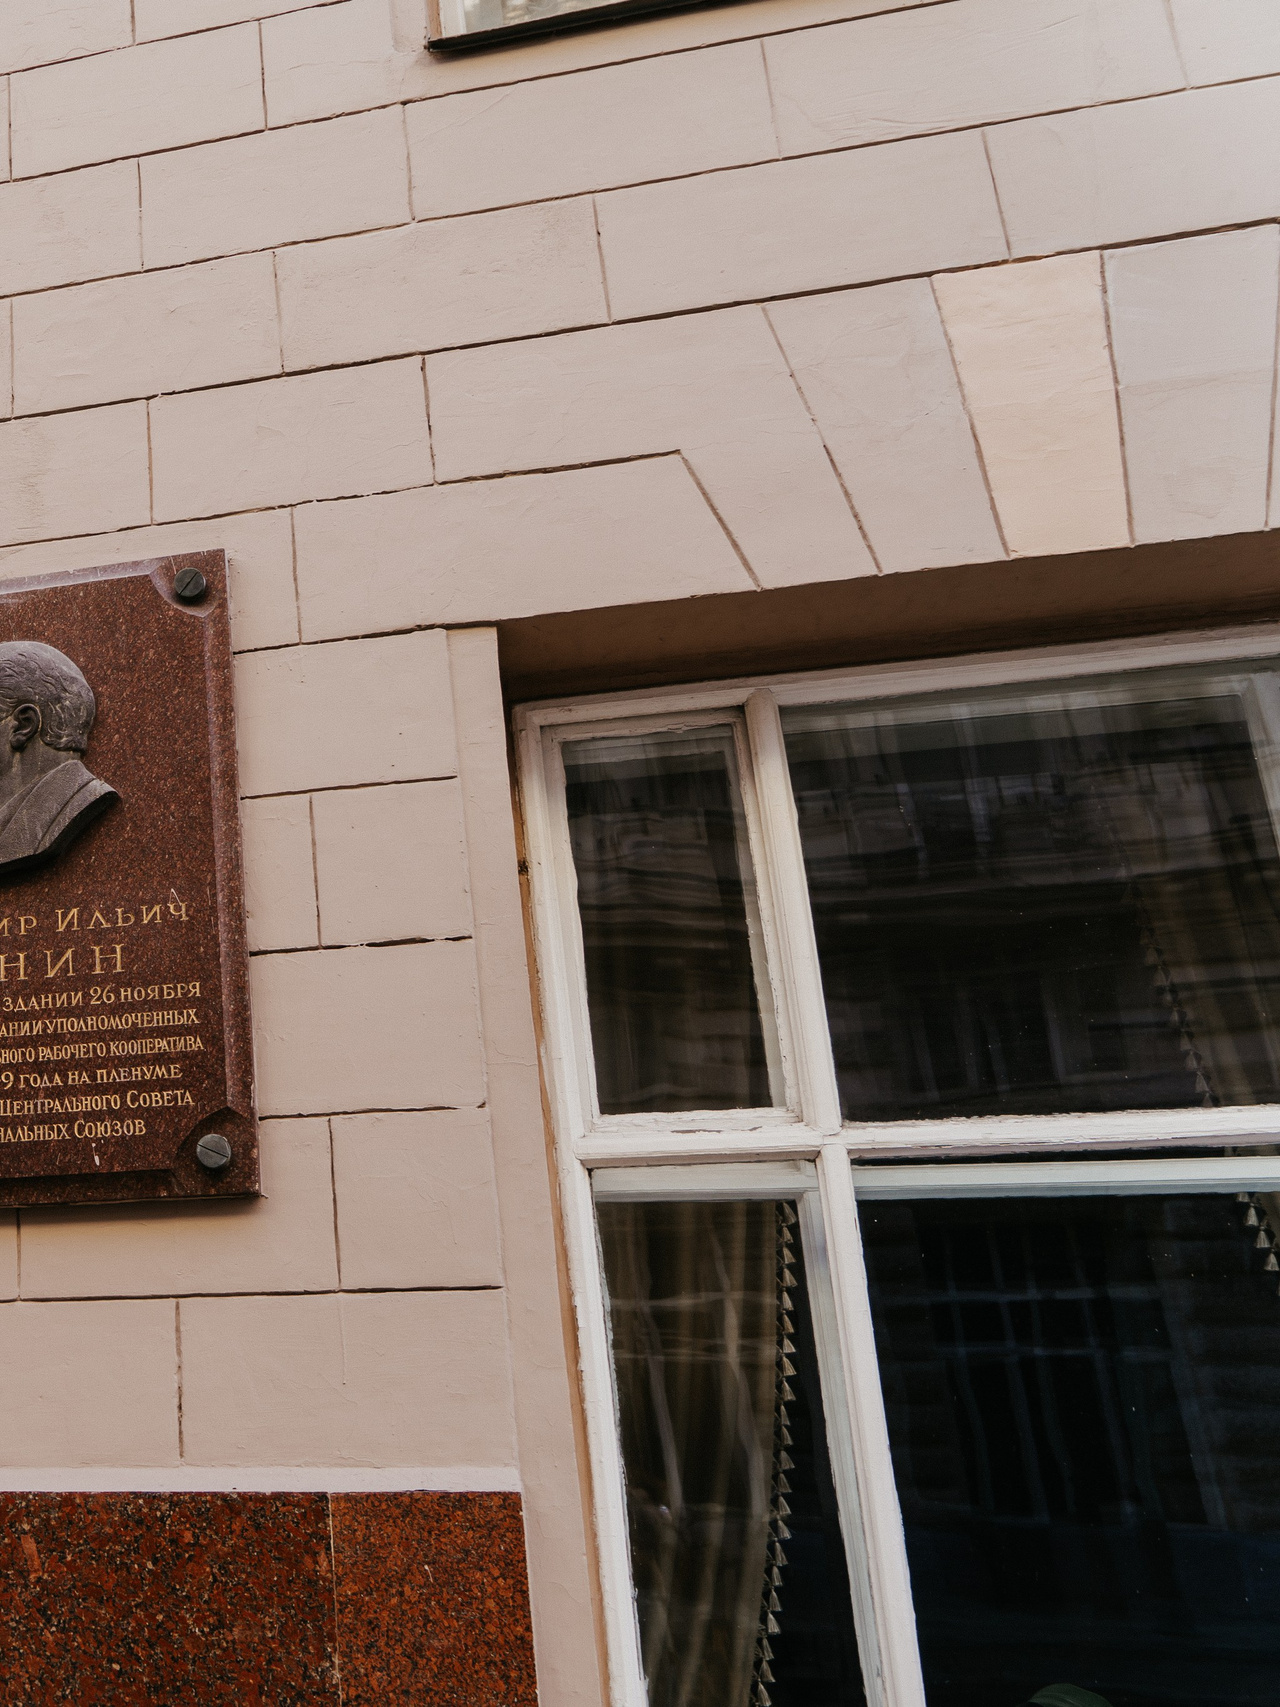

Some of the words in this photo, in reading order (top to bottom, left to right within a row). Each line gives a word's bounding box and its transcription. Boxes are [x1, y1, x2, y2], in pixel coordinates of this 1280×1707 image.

[55, 901, 189, 932] ИЛЬИЧ
[2, 991, 83, 1013] ЗДАНИИ
[89, 984, 115, 1005] 26
[119, 981, 202, 1003] НОЯБРЯ
[44, 1008, 200, 1034] УПОЛНОМОЧЕННЫХ
[38, 1041, 106, 1062] РАБОЧЕГО
[109, 1034, 204, 1057] КООПЕРАТИВА
[19, 1072, 64, 1089] ГОДА
[67, 1070, 93, 1085] НА
[96, 1064, 183, 1084] ПЛЕНУМЕ
[0, 1094, 121, 1117] ЦЕНТРАЛЬНОГО
[126, 1089, 196, 1109] СОВЕТА
[74, 1118, 147, 1139] СОЮЗОВ
